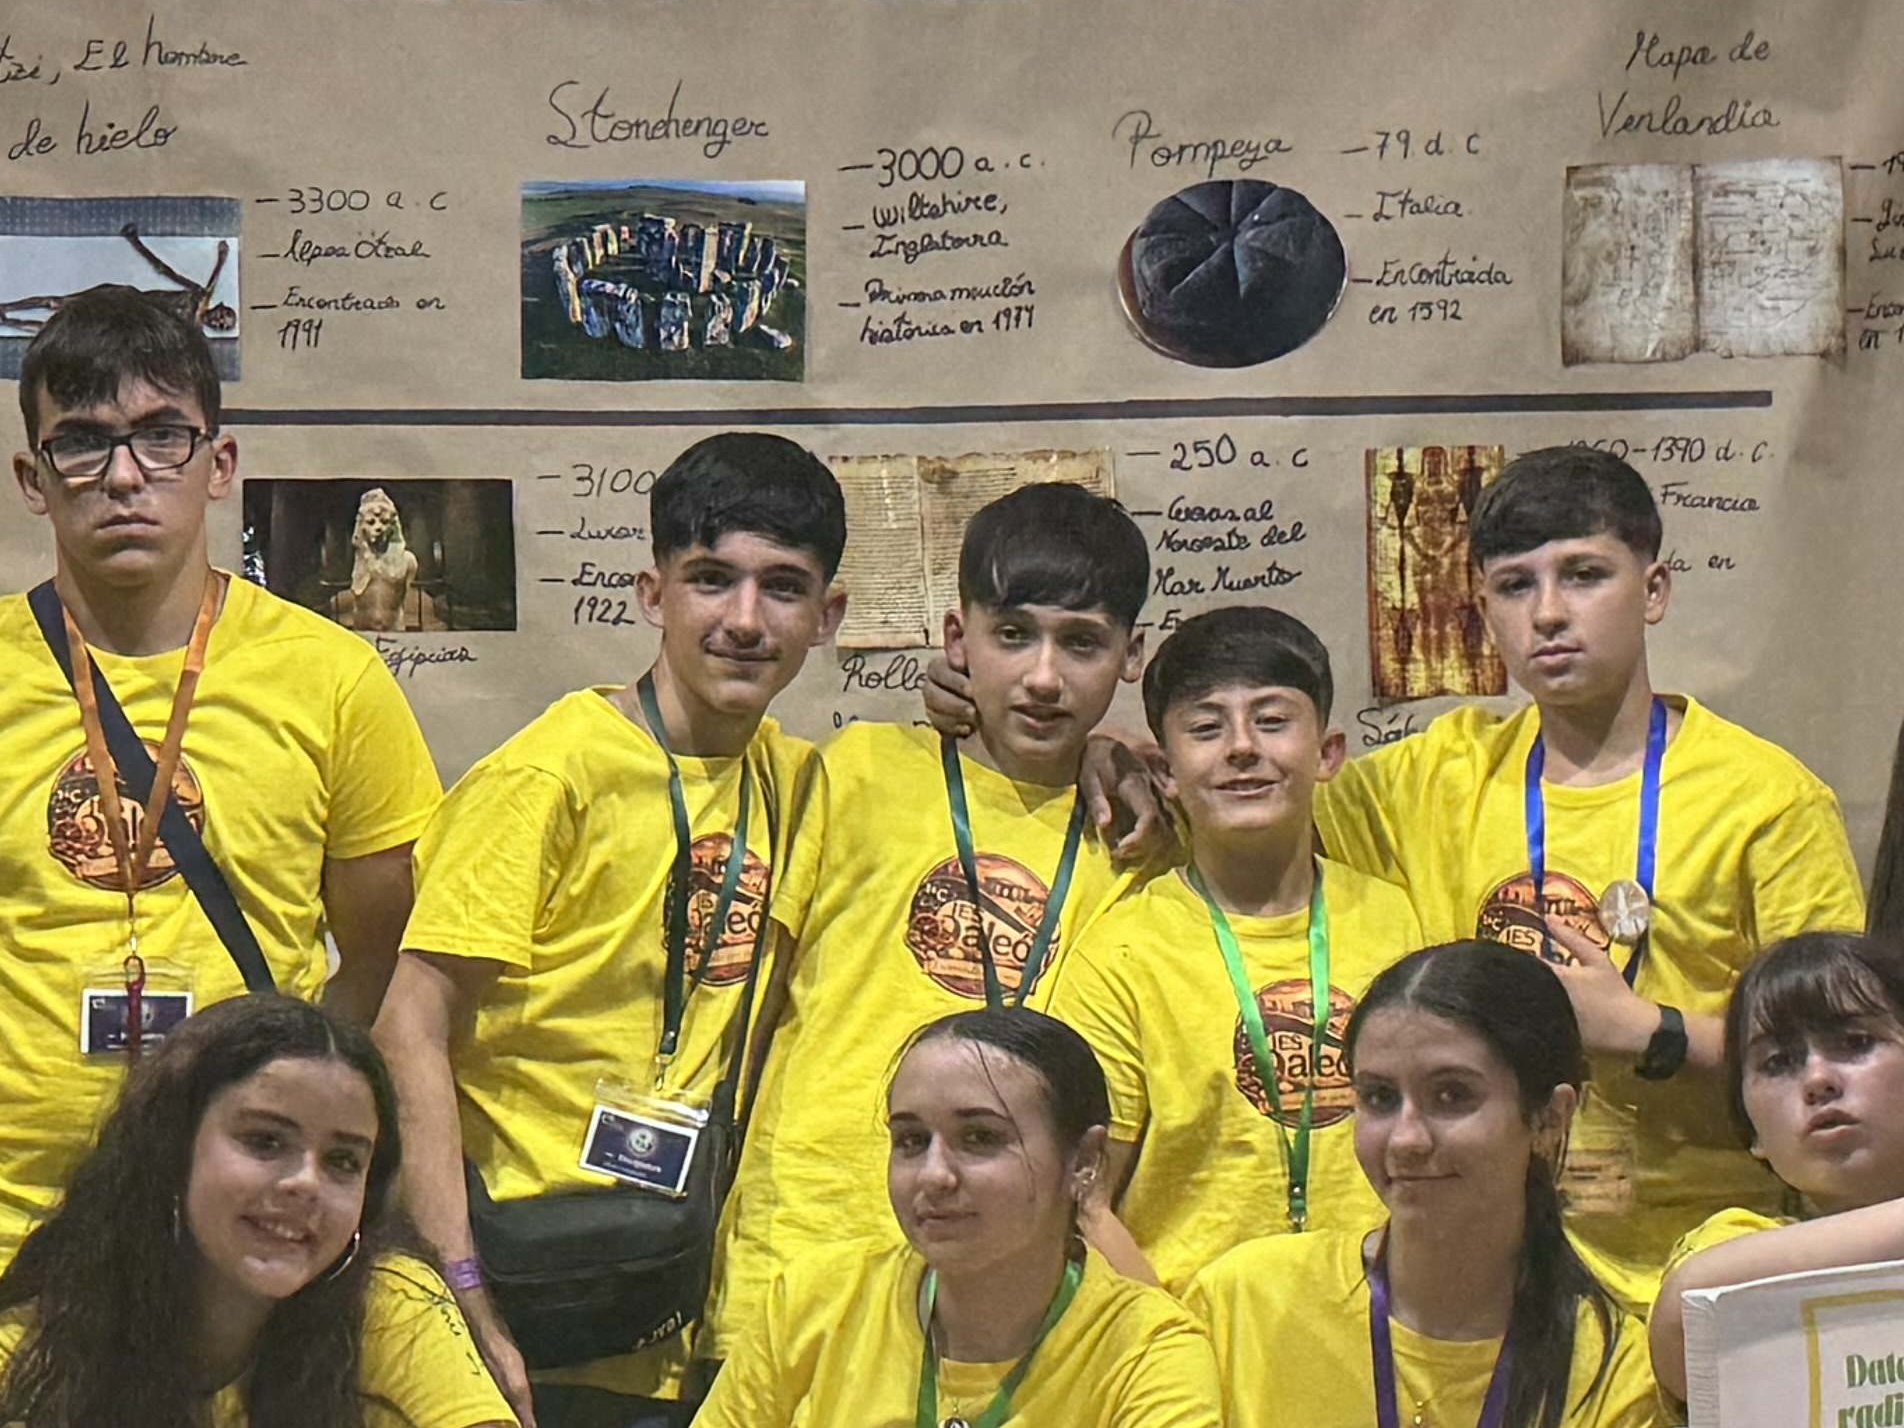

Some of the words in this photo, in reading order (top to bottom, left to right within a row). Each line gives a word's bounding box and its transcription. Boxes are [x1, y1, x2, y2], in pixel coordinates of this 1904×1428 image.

[1728, 29, 1771, 62] de
[8, 119, 57, 161] de
[1111, 110, 1293, 178] Pompeya
[1507, 928, 1534, 946] IES
